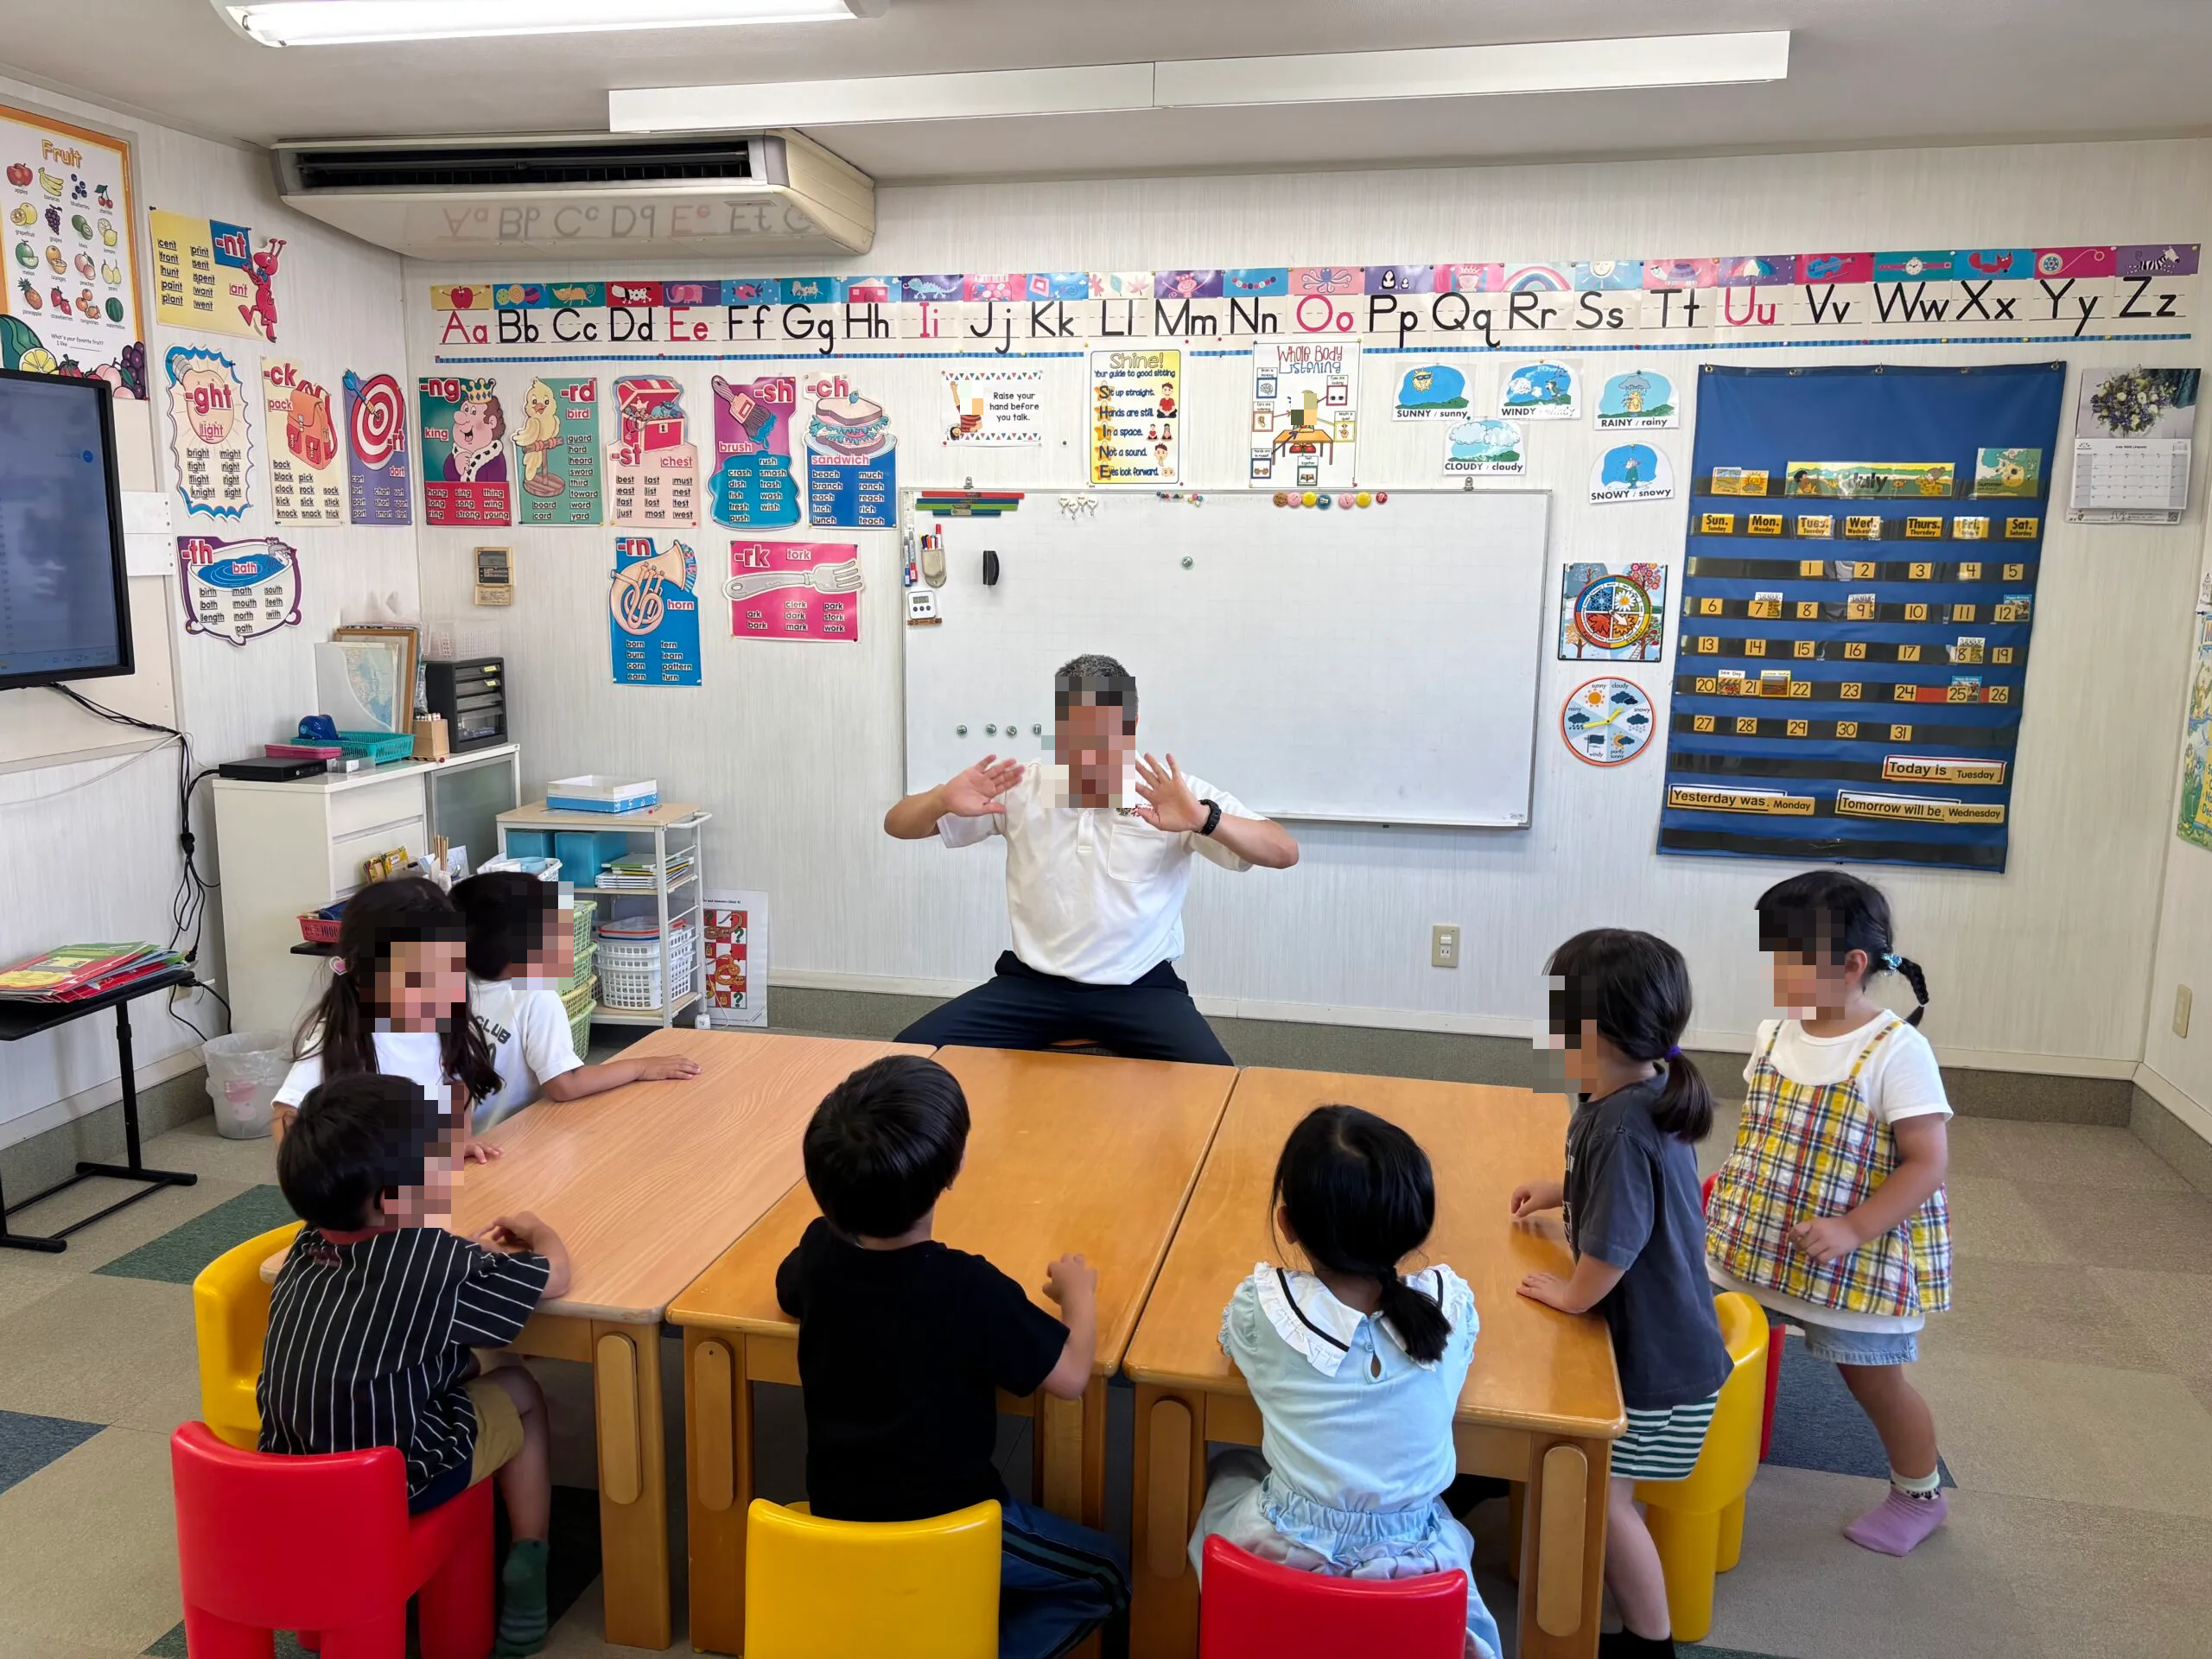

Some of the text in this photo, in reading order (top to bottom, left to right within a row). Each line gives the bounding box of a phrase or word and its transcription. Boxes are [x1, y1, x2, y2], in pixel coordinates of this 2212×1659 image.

[41, 139, 82, 168] Fruit
[216, 233, 245, 257] -nt
[231, 284, 247, 296] ant
[162, 295, 182, 305] plant
[442, 276, 2177, 355] Aa Bb Cc Dd Ee Ff Gg Hh Ii Jj Kk Ll Mm Nn Oo Pp Qq Rr Ss Tt Uu Vv Ww Xx Yy Zz
[1109, 353, 1163, 369] Shine!
[264, 363, 297, 386] -ck
[1109, 370, 1125, 378] guide
[1137, 370, 1152, 378] good
[421, 379, 459, 401] -ng
[562, 380, 594, 401] -rd
[755, 381, 791, 402] -sh
[808, 376, 849, 397] -ch
[1100, 385, 1114, 398] Sit
[186, 383, 232, 414] -ght
[269, 400, 292, 410] pack
[567, 410, 588, 418] bird
[1100, 406, 1124, 419] Hands
[1141, 408, 1154, 416] still.
[1602, 418, 1667, 427] RAINY rainy
[201, 424, 223, 439] light
[425, 429, 448, 440] king
[1103, 424, 1113, 437] In
[1120, 429, 1142, 439] space.
[720, 442, 751, 451] brush
[1100, 446, 1117, 458] Not
[612, 444, 641, 465] -st
[663, 457, 692, 466] chest
[391, 467, 404, 475] dart
[1100, 465, 1118, 478] Eyes
[1133, 467, 1158, 476] forward.
[1445, 462, 1522, 472] CLOUDY cloudy
[1592, 488, 1671, 500] SNOWY snowy
[1707, 515, 2032, 530] Sun. Mon. Tues. Wed. Thurs. Sat.
[182, 540, 213, 564] -th
[618, 540, 650, 555] -rn
[735, 546, 810, 566] -rk fork
[233, 563, 257, 573] bath
[1861, 564, 2018, 577] 2 3 5
[1708, 600, 2011, 620] 6 8 10 11 12
[1702, 639, 1916, 658] 13 14 15 16 17
[1698, 679, 2006, 701] 20 22 23 24 26
[1697, 717, 1855, 735] 27 30
[1890, 762, 1994, 780] Today is Tuesday
[1674, 790, 1736, 806] Yesterday
[1774, 800, 1810, 810] Monday
[1842, 798, 1901, 813] Tomorrow
[1904, 804, 1923, 816] will
[1949, 809, 2000, 819] Wednesday
